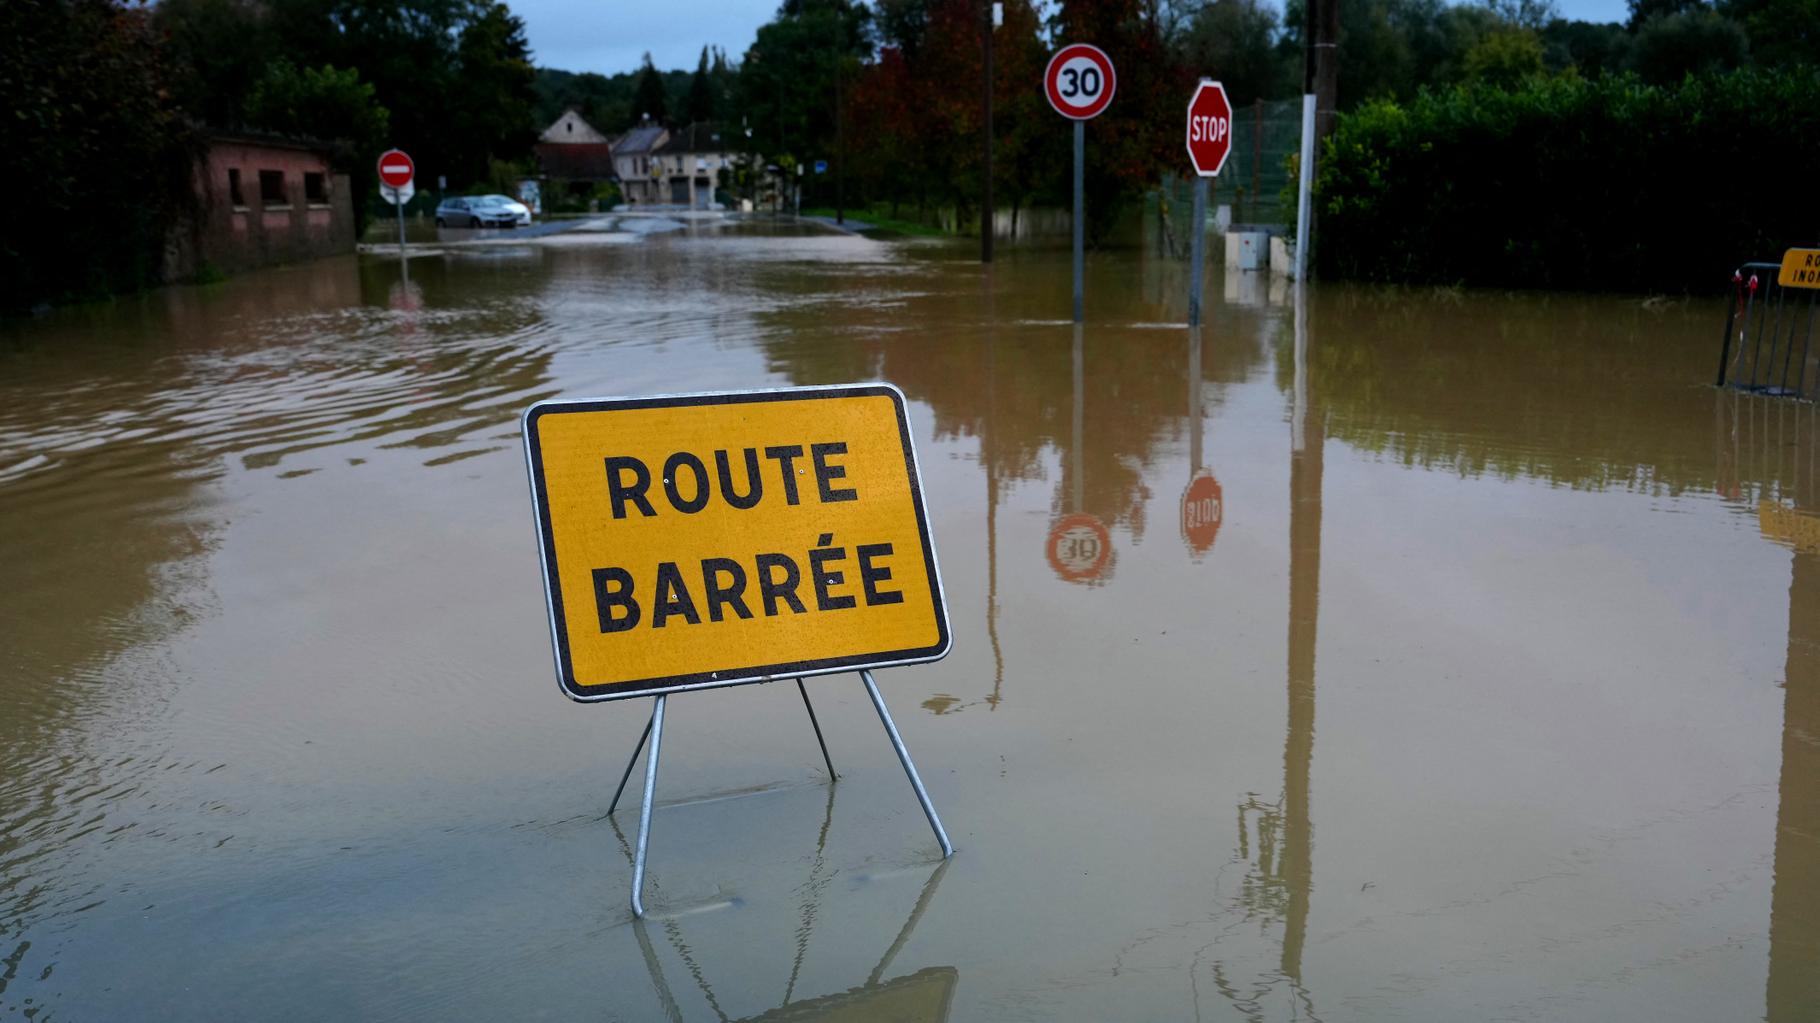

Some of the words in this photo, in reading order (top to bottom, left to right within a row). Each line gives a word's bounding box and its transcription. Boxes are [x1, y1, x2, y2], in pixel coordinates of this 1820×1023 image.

[1062, 67, 1100, 98] 30
[1191, 115, 1227, 143] STOP
[604, 442, 858, 519] ROUTE
[591, 532, 904, 634] BARRÉE
